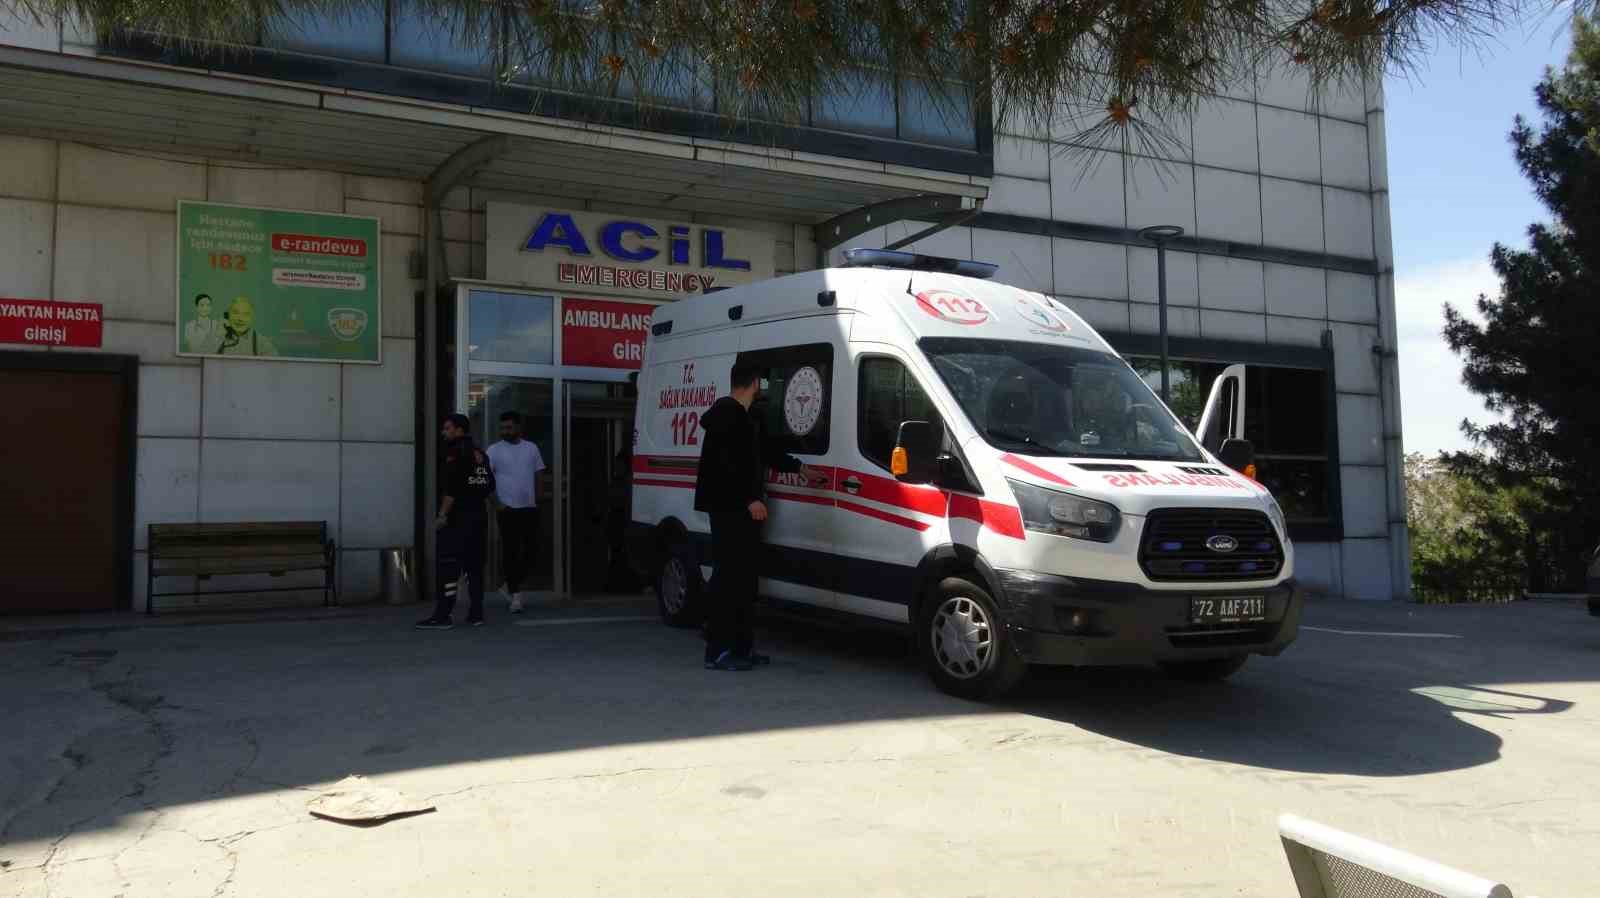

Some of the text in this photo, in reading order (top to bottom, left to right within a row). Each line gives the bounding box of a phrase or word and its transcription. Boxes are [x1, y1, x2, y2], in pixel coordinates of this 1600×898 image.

[280, 238, 360, 256] e-randevu
[208, 253, 248, 271] 182
[559, 263, 717, 292] EMERGENCY
[57, 307, 99, 322] HASTA
[936, 296, 989, 316] 112
[564, 309, 651, 331] AMBULANS
[24, 326, 67, 344] GİRİŞİ
[671, 411, 698, 446] 112
[1199, 599, 1262, 616] 72 AAF 211
